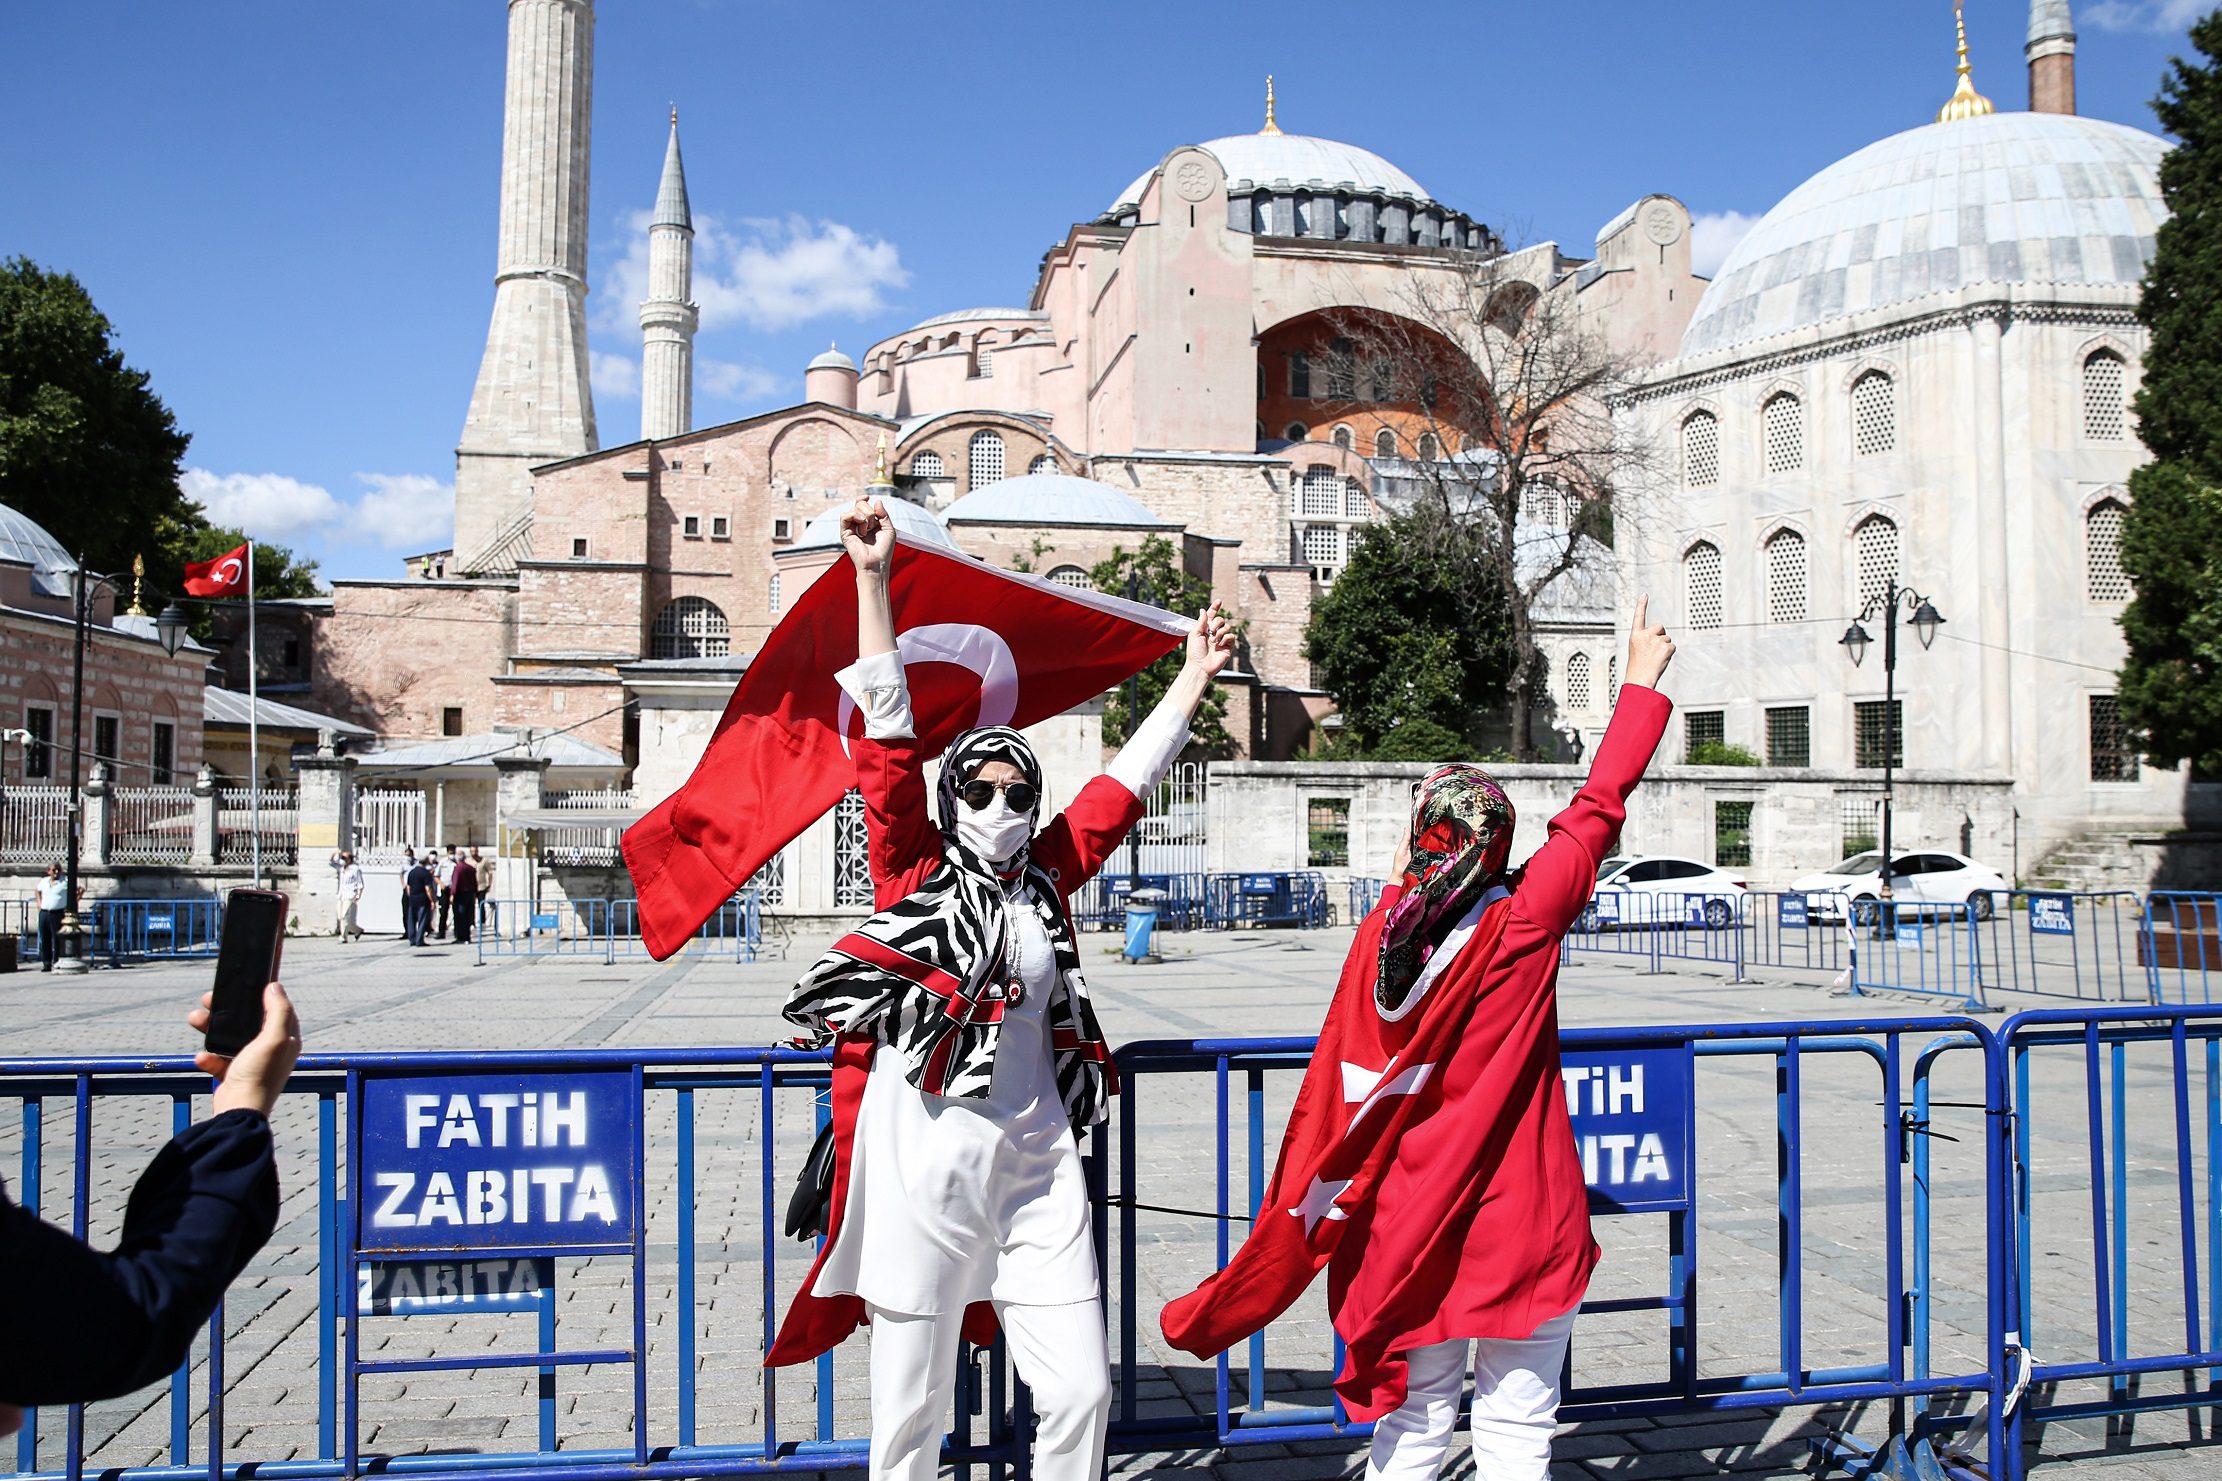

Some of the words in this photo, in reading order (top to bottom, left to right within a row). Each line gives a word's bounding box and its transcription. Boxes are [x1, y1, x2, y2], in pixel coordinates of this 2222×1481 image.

[1561, 1065, 1644, 1116] TiH
[1575, 1132, 1670, 1186] ITA
[373, 1165, 618, 1228] ZABITA
[358, 1259, 544, 1310] ZABITA
